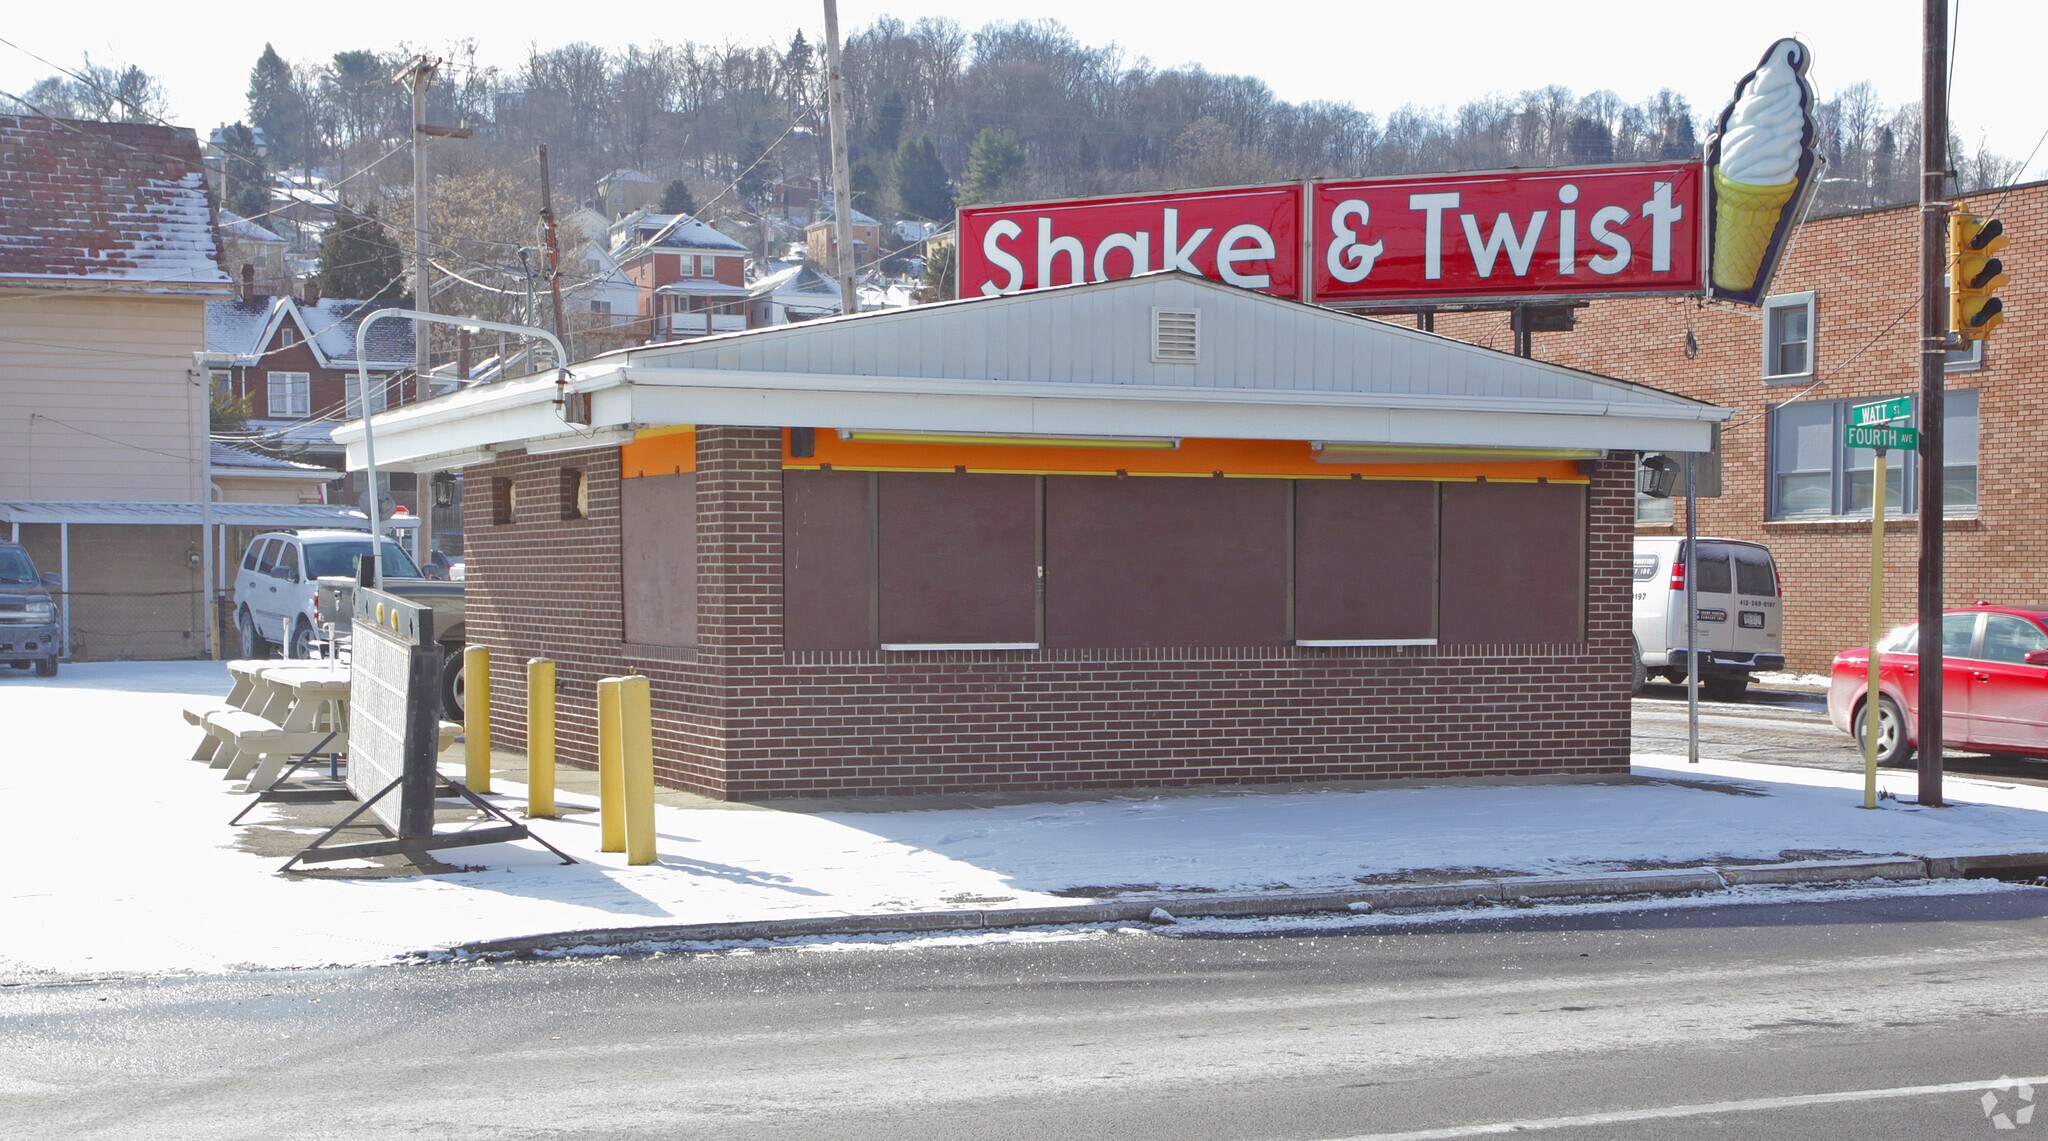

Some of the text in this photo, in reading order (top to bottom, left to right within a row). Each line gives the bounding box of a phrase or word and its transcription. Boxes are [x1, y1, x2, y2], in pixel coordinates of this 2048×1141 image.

[980, 180, 1684, 297] Shake & Twist
[1862, 404, 1900, 424] WATT ST
[1848, 428, 1913, 446] FOURTH AVE
